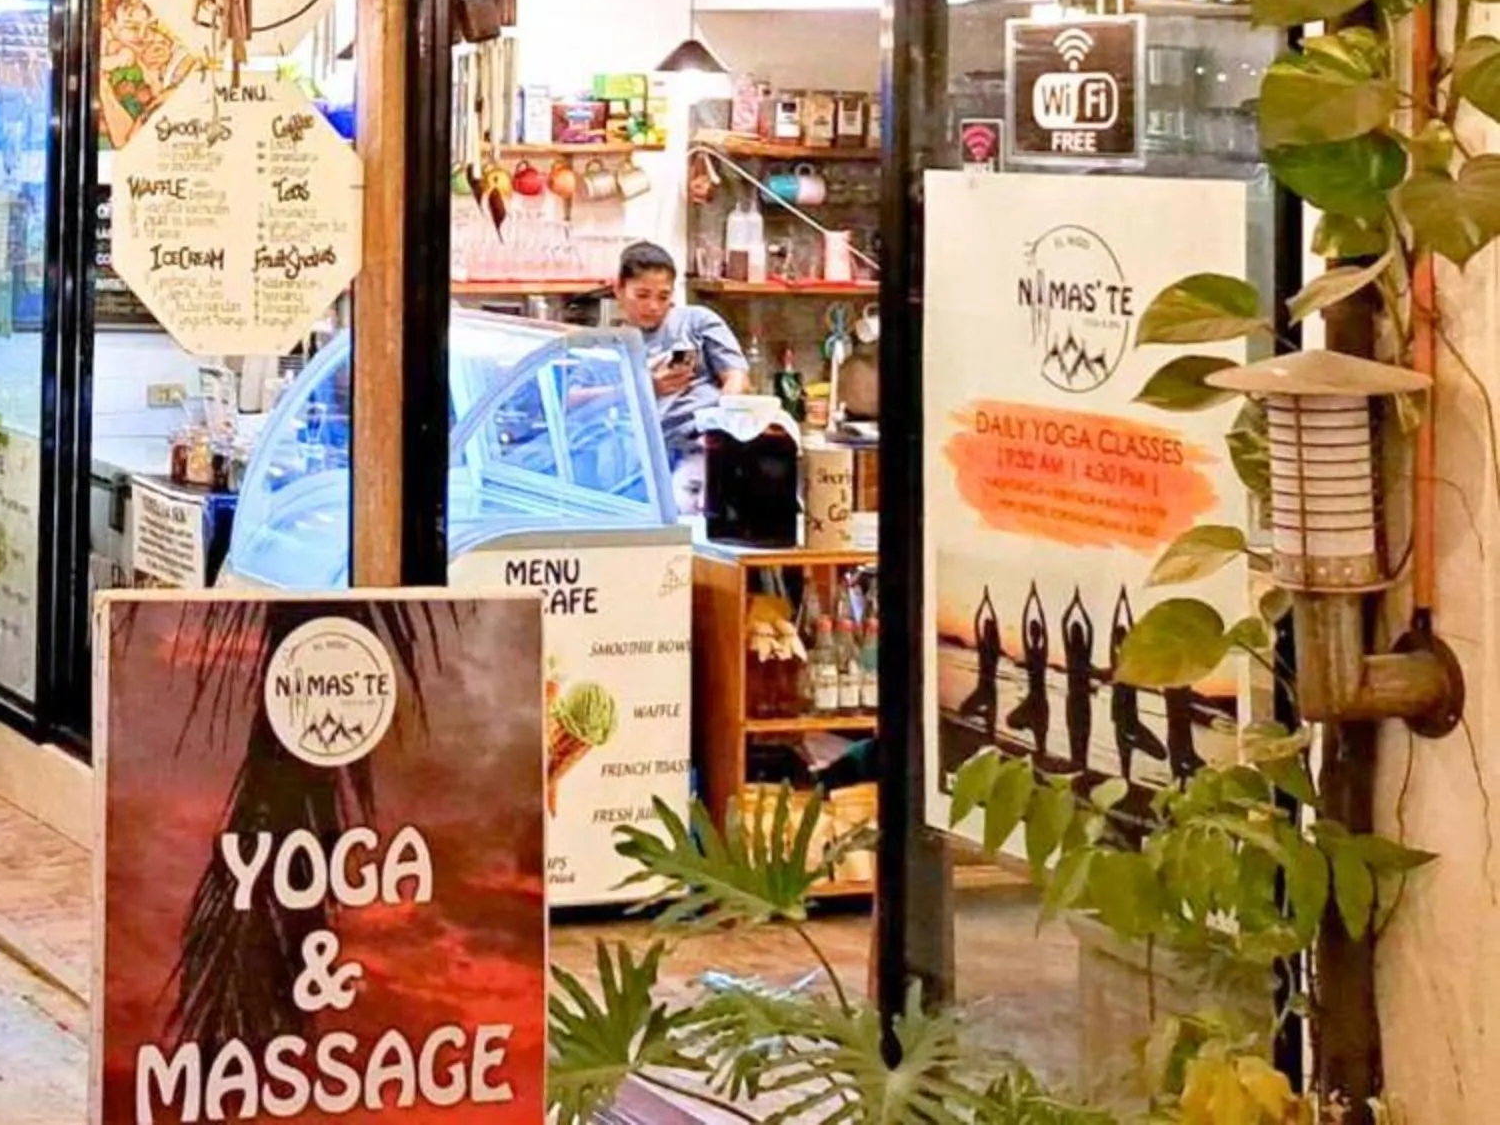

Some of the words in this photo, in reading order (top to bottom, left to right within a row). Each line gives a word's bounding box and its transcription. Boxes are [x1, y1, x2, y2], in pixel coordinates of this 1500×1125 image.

[215, 86, 268, 103] MENU
[1051, 131, 1097, 153] FREE
[975, 410, 1025, 441] DAILY
[1032, 419, 1095, 451] YOGA
[1098, 429, 1185, 466] CLASSES
[505, 559, 581, 586] MENU
[601, 761, 651, 778] FRENCH
[592, 806, 633, 824] FRESH
[221, 826, 434, 910] YOGA
[293, 930, 363, 1011] &
[136, 1024, 514, 1125] MASSAGE
